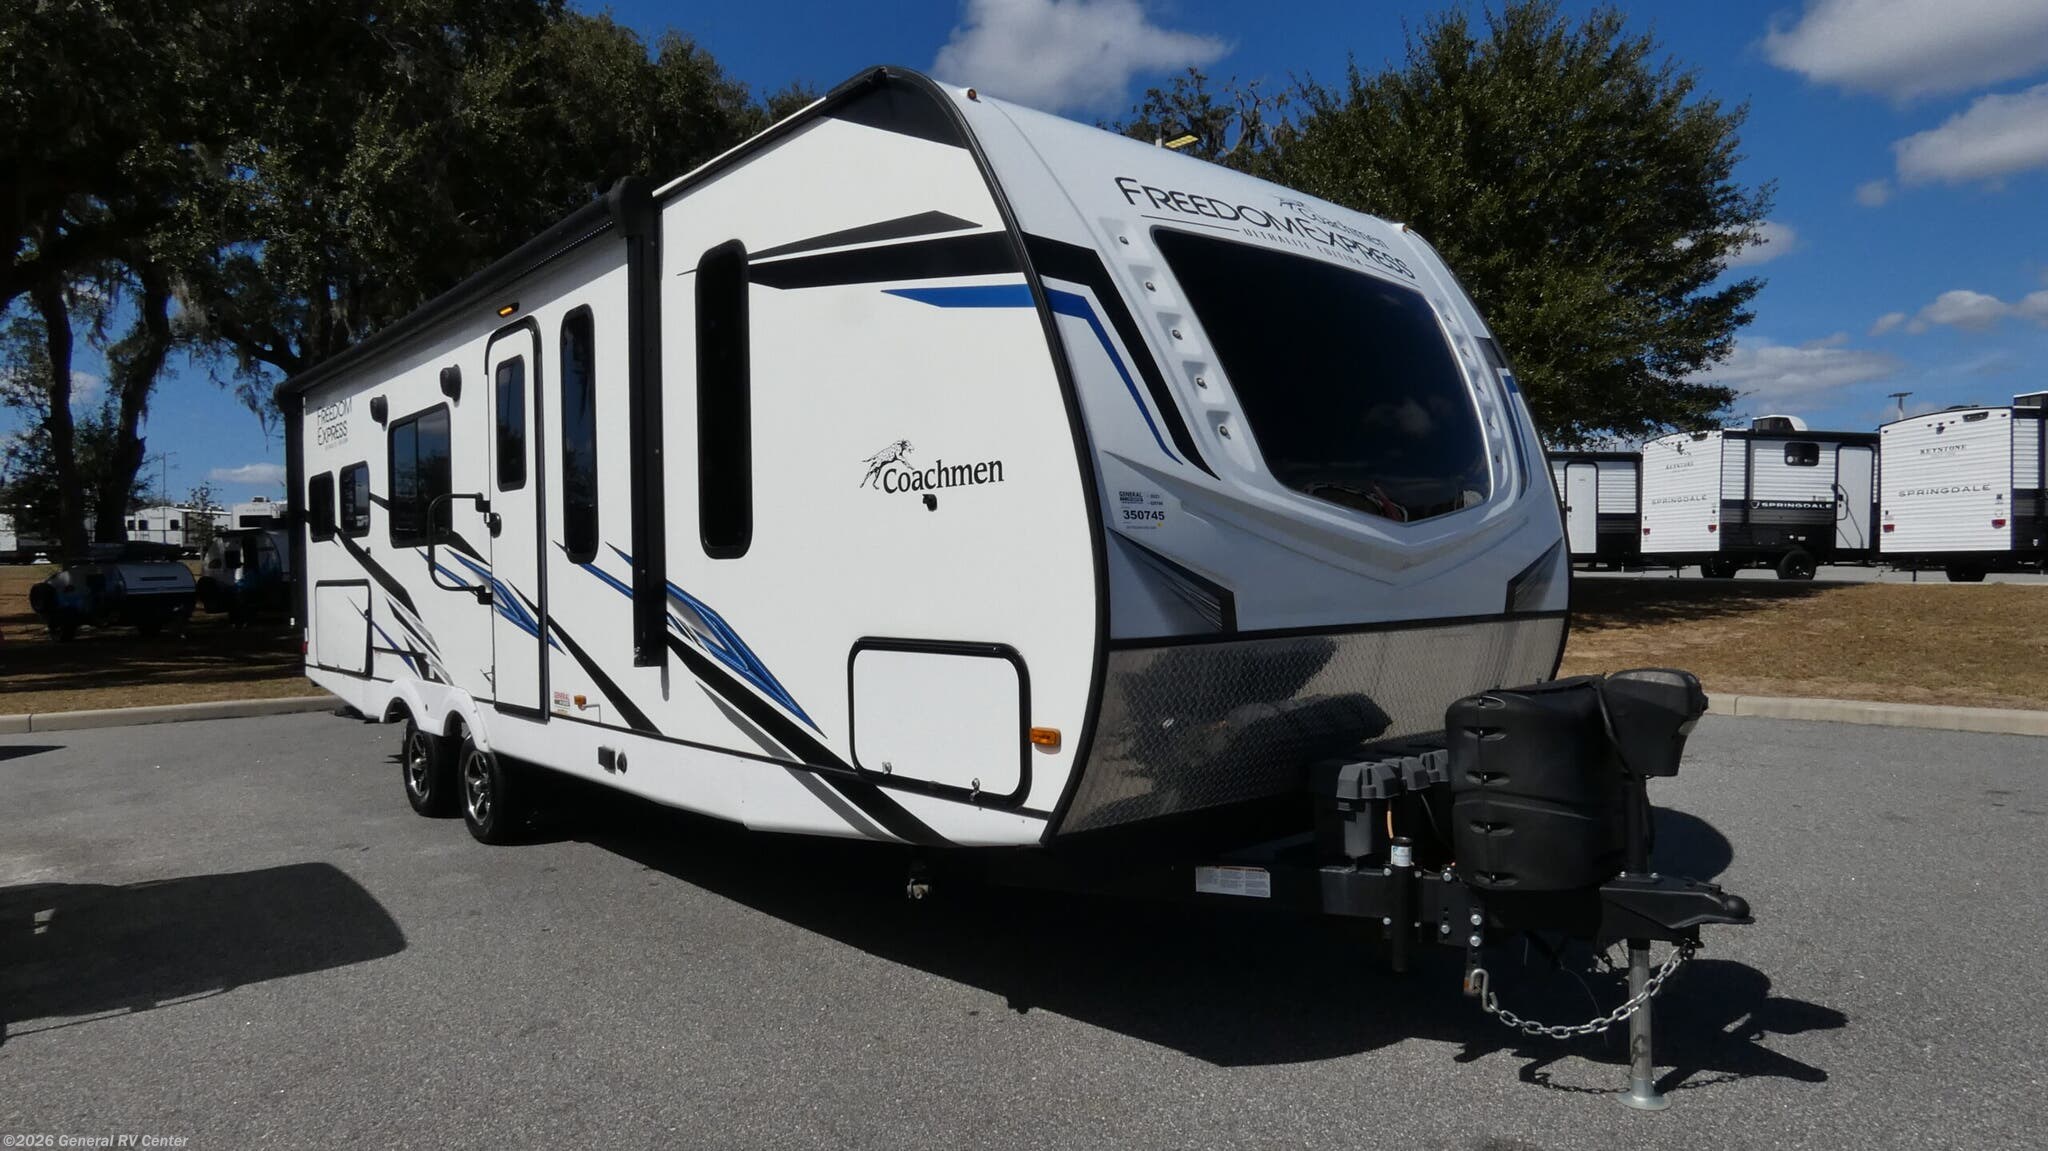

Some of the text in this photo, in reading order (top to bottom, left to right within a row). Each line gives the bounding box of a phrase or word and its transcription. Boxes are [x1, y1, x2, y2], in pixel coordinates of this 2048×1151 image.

[1114, 176, 1416, 279] FREEDOM EXPRESS
[317, 420, 348, 446] EXPRESS
[1920, 444, 1967, 455] KEYSTONE
[883, 459, 1005, 494] Coachmen
[1898, 483, 1992, 498] SPRINGDALE
[1652, 494, 1707, 505] SPRINGDALE
[1123, 509, 1165, 521] 350745
